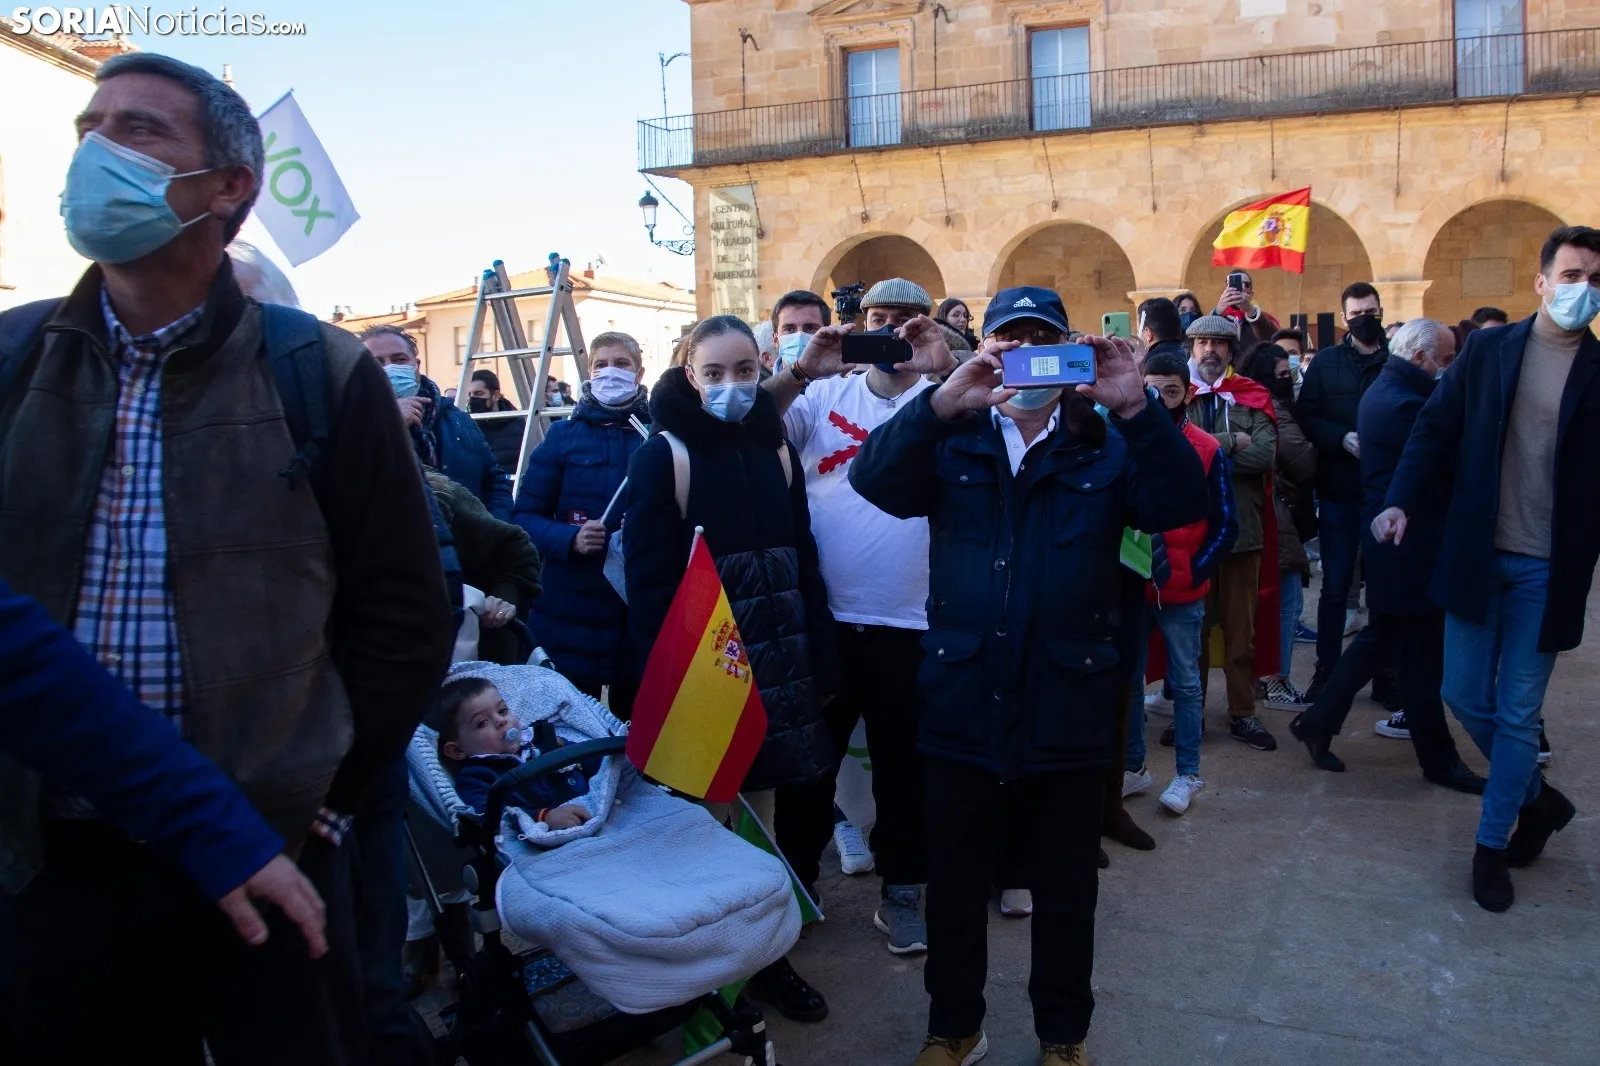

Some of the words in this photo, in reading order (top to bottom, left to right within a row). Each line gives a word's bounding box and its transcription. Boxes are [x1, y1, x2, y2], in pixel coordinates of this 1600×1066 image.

[264, 131, 336, 237] VOX
[715, 203, 750, 214] CENTRO
[711, 217, 756, 231] CULTURAL
[716, 236, 752, 247] PALACIO
[717, 254, 729, 264] DE
[739, 253, 751, 262] LA
[713, 269, 757, 280] AUDIENCIA
[721, 306, 750, 315] TEATRO
